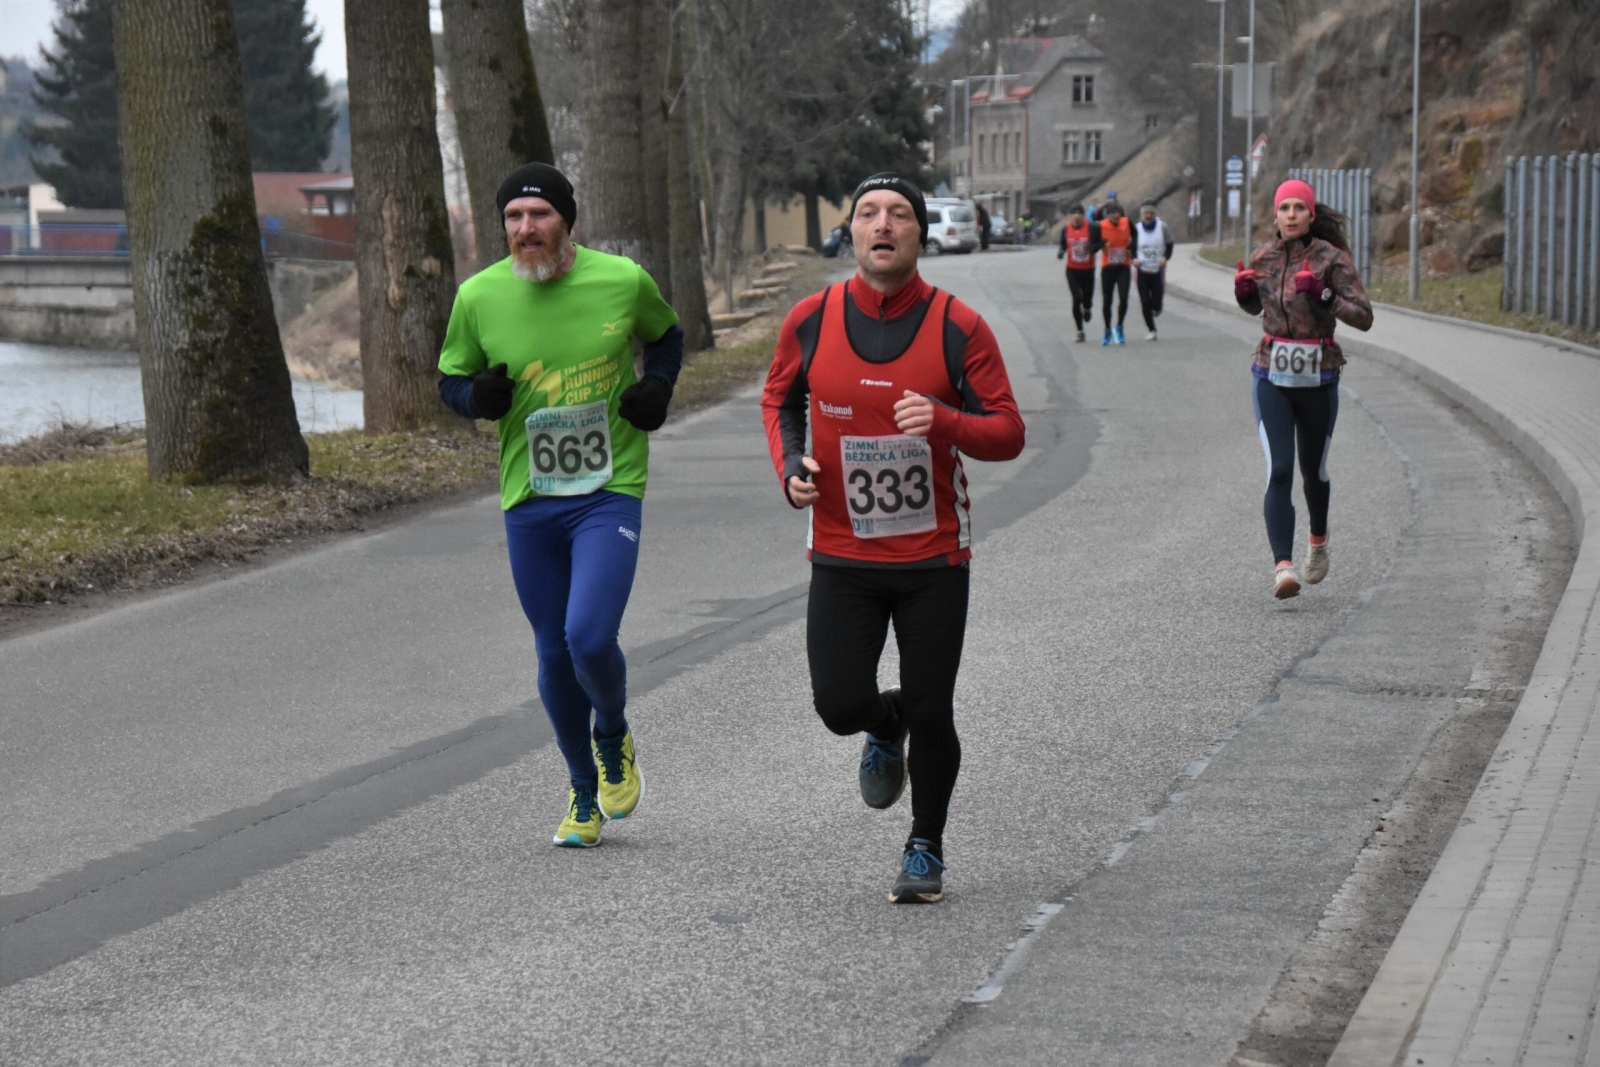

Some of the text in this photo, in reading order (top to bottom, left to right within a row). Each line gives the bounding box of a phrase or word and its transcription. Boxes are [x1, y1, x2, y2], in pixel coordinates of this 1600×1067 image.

[578, 354, 608, 371] MIZUNO
[1275, 345, 1318, 375] 661
[565, 359, 618, 391] RUNNING
[565, 387, 592, 406] CUP
[529, 410, 561, 423] ZIMNÍ
[581, 414, 605, 427] LIGA
[532, 431, 609, 474] 663
[844, 439, 879, 451] ZIMNÍ
[901, 448, 928, 459] LIGA
[848, 464, 931, 515] 333
